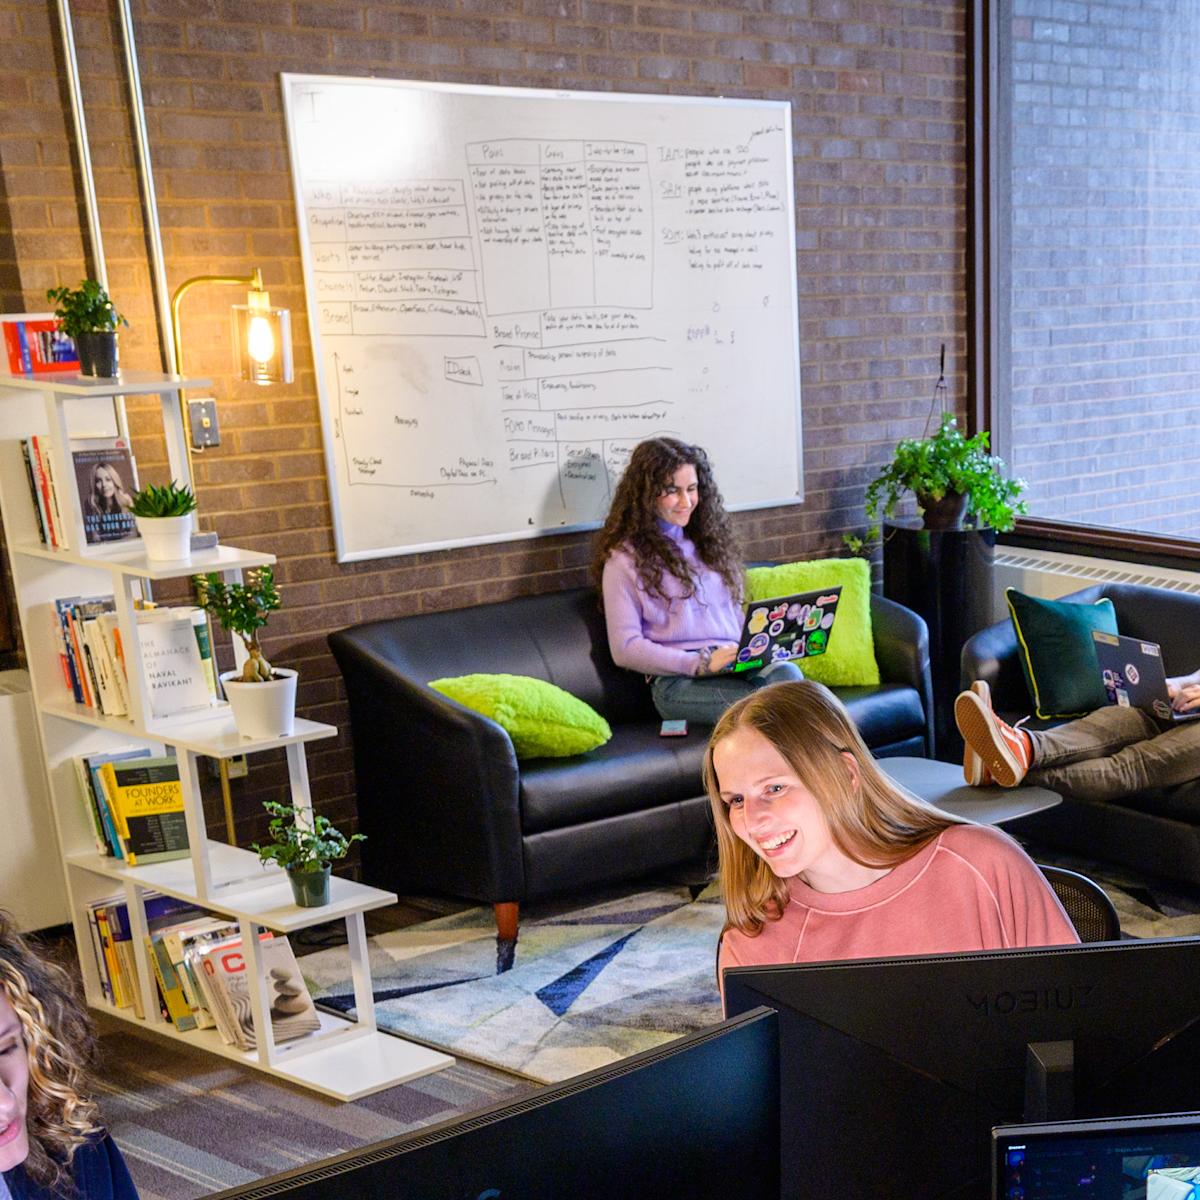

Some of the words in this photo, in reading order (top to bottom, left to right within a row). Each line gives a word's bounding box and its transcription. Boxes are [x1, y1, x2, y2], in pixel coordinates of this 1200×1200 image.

[149, 669, 176, 679] NAVAL
[152, 678, 192, 689] RAVIKANT
[126, 784, 179, 798] FOUNDERS
[146, 795, 176, 806] WORK
